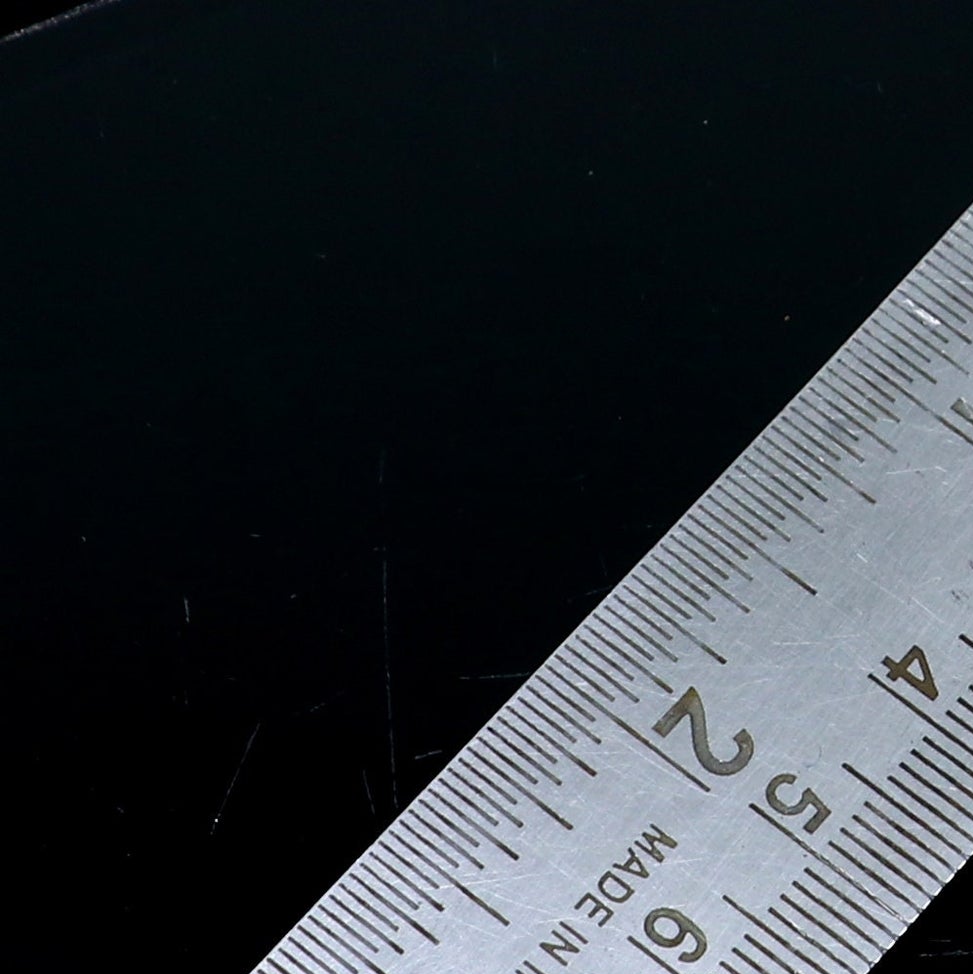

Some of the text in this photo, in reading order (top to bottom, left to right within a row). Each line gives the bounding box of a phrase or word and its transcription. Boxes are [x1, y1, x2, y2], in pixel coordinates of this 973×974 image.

[882, 645, 938, 701] 4
[652, 686, 754, 776] 2
[765, 773, 832, 834] 5
[574, 823, 678, 927] MADE
[539, 921, 589, 966] IN
[643, 907, 708, 963] 6
